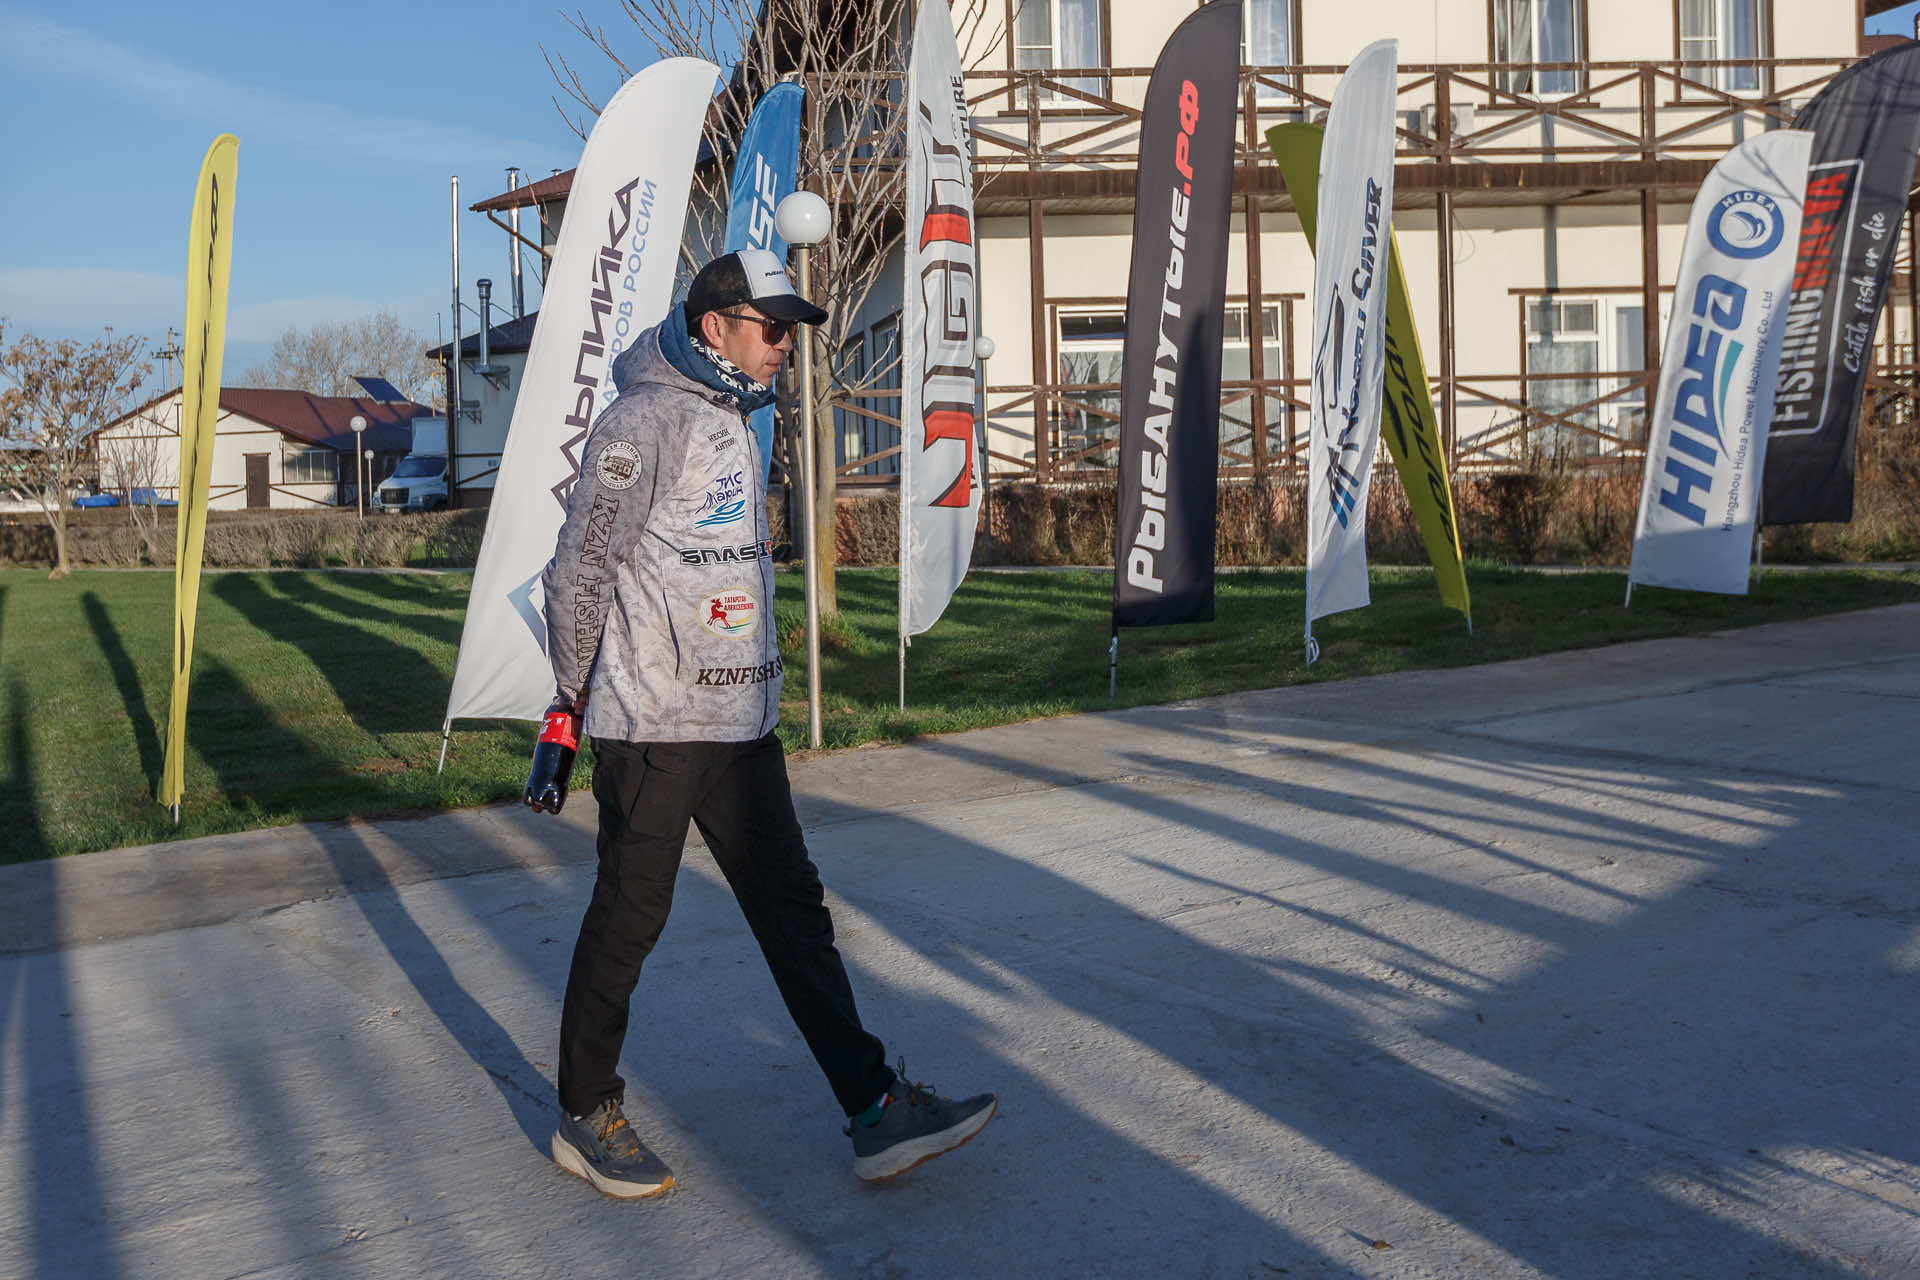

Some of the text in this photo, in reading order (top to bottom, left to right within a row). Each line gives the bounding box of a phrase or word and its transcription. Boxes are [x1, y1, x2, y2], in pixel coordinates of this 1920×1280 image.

[1722, 192, 1775, 212] HIDEA
[623, 179, 657, 292] РОССИИ
[1843, 210, 1886, 373] Catch fish or die
[1746, 339, 1768, 395] Machinery
[1659, 274, 1747, 526] HIDEA
[1739, 400, 1755, 434] Power
[1733, 438, 1748, 470] Hidea
[580, 494, 620, 568] KZN
[1720, 473, 1742, 532] Hangzhou
